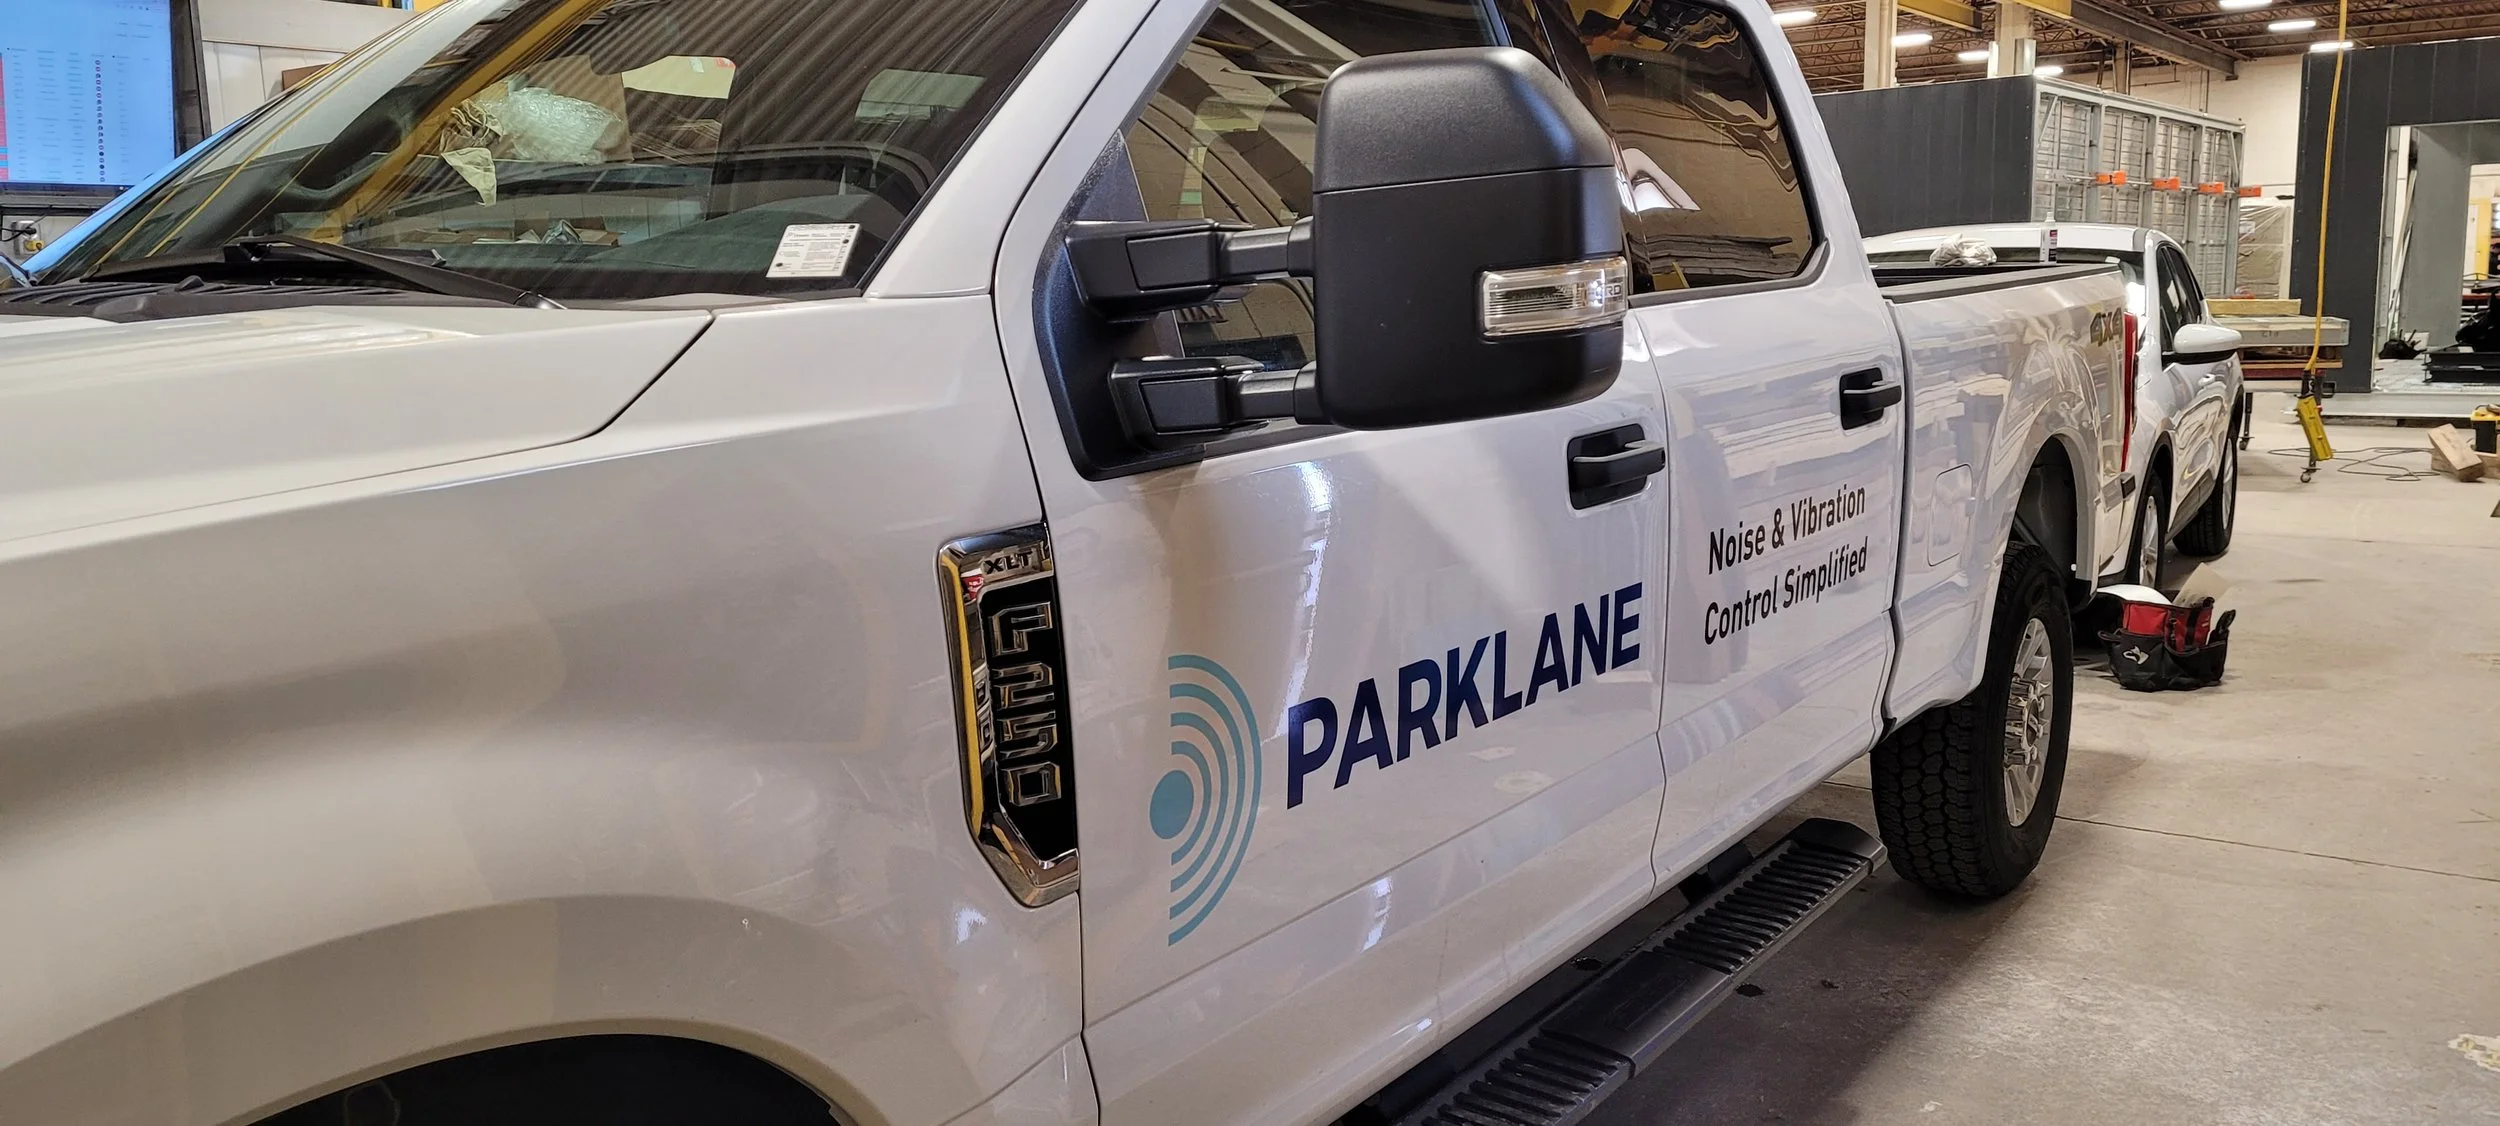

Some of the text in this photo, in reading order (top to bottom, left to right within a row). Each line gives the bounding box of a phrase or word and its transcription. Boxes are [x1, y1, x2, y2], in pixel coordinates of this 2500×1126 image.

[984, 547, 1034, 575] XLT
[1708, 484, 1866, 575] Noise & Vibration
[1704, 536, 1868, 645] Control Simplified
[1287, 582, 1643, 810] PARKLANE
